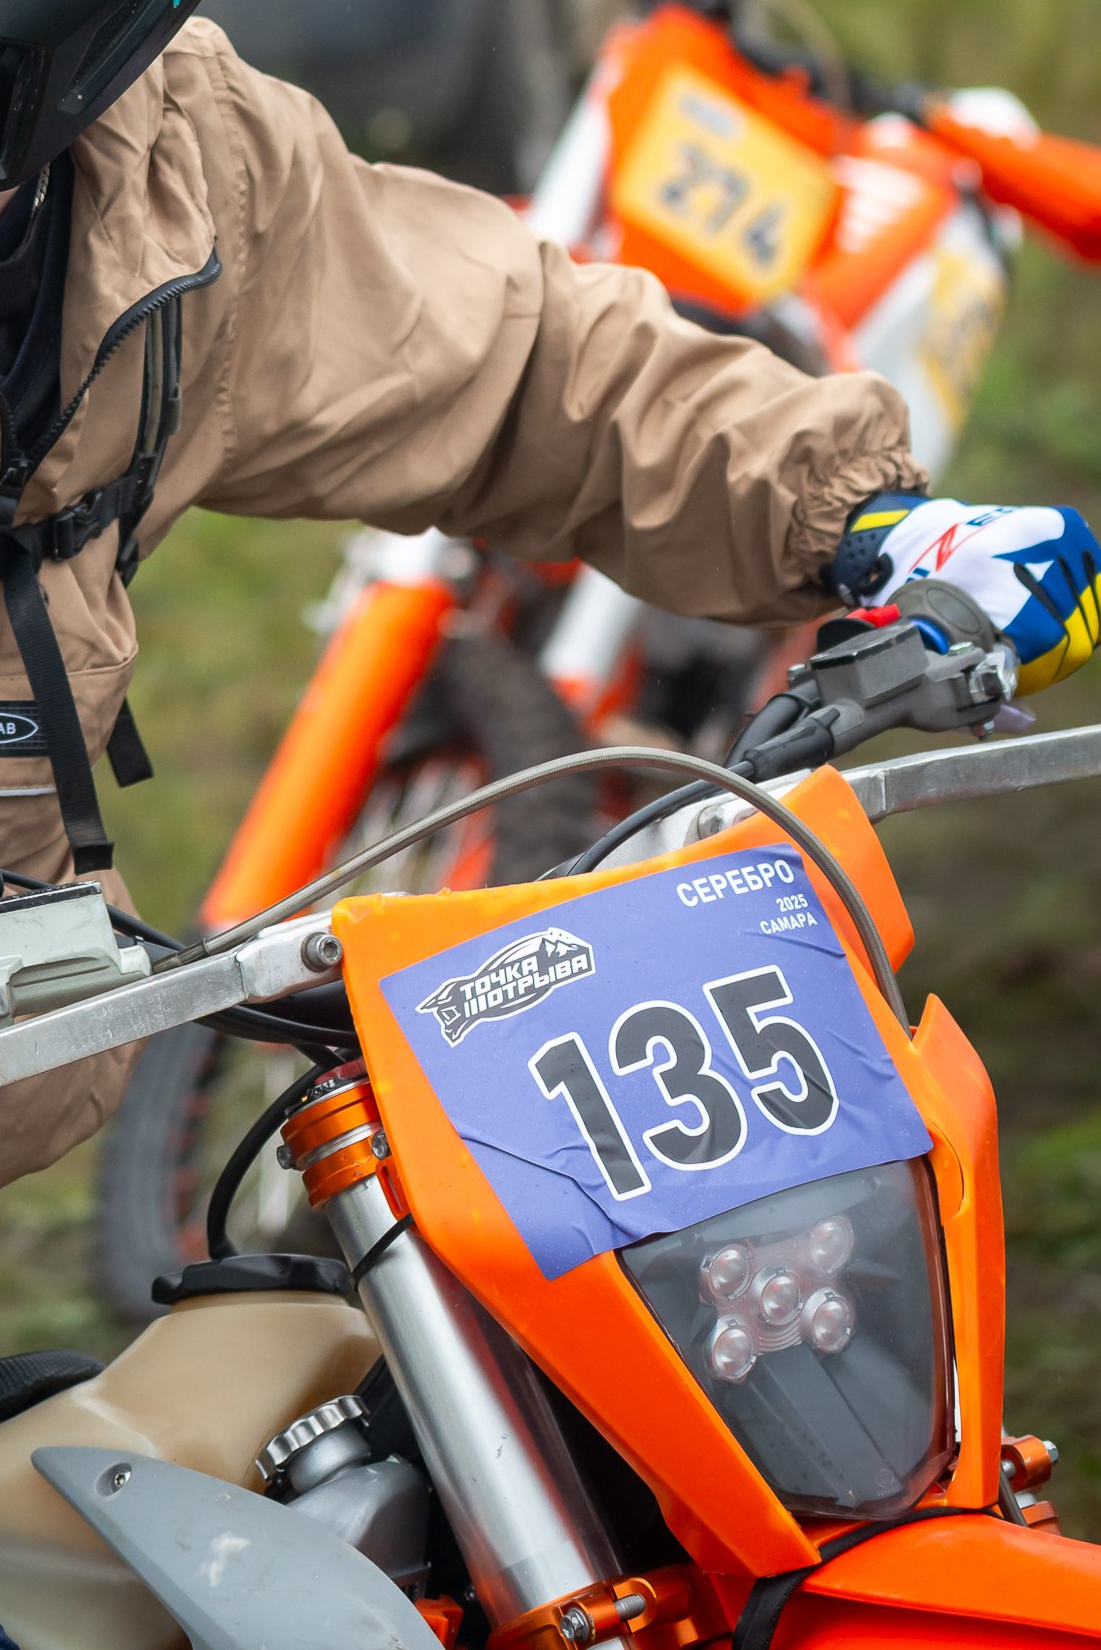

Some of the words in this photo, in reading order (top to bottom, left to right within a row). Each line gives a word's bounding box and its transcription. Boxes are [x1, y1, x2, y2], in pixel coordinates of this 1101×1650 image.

[676, 859, 795, 907] СЕРЕБРО
[776, 893, 809, 913] 2025
[759, 912, 818, 935] САМАРА
[459, 955, 539, 1000] ТОЧКА
[530, 965, 839, 1201] 135
